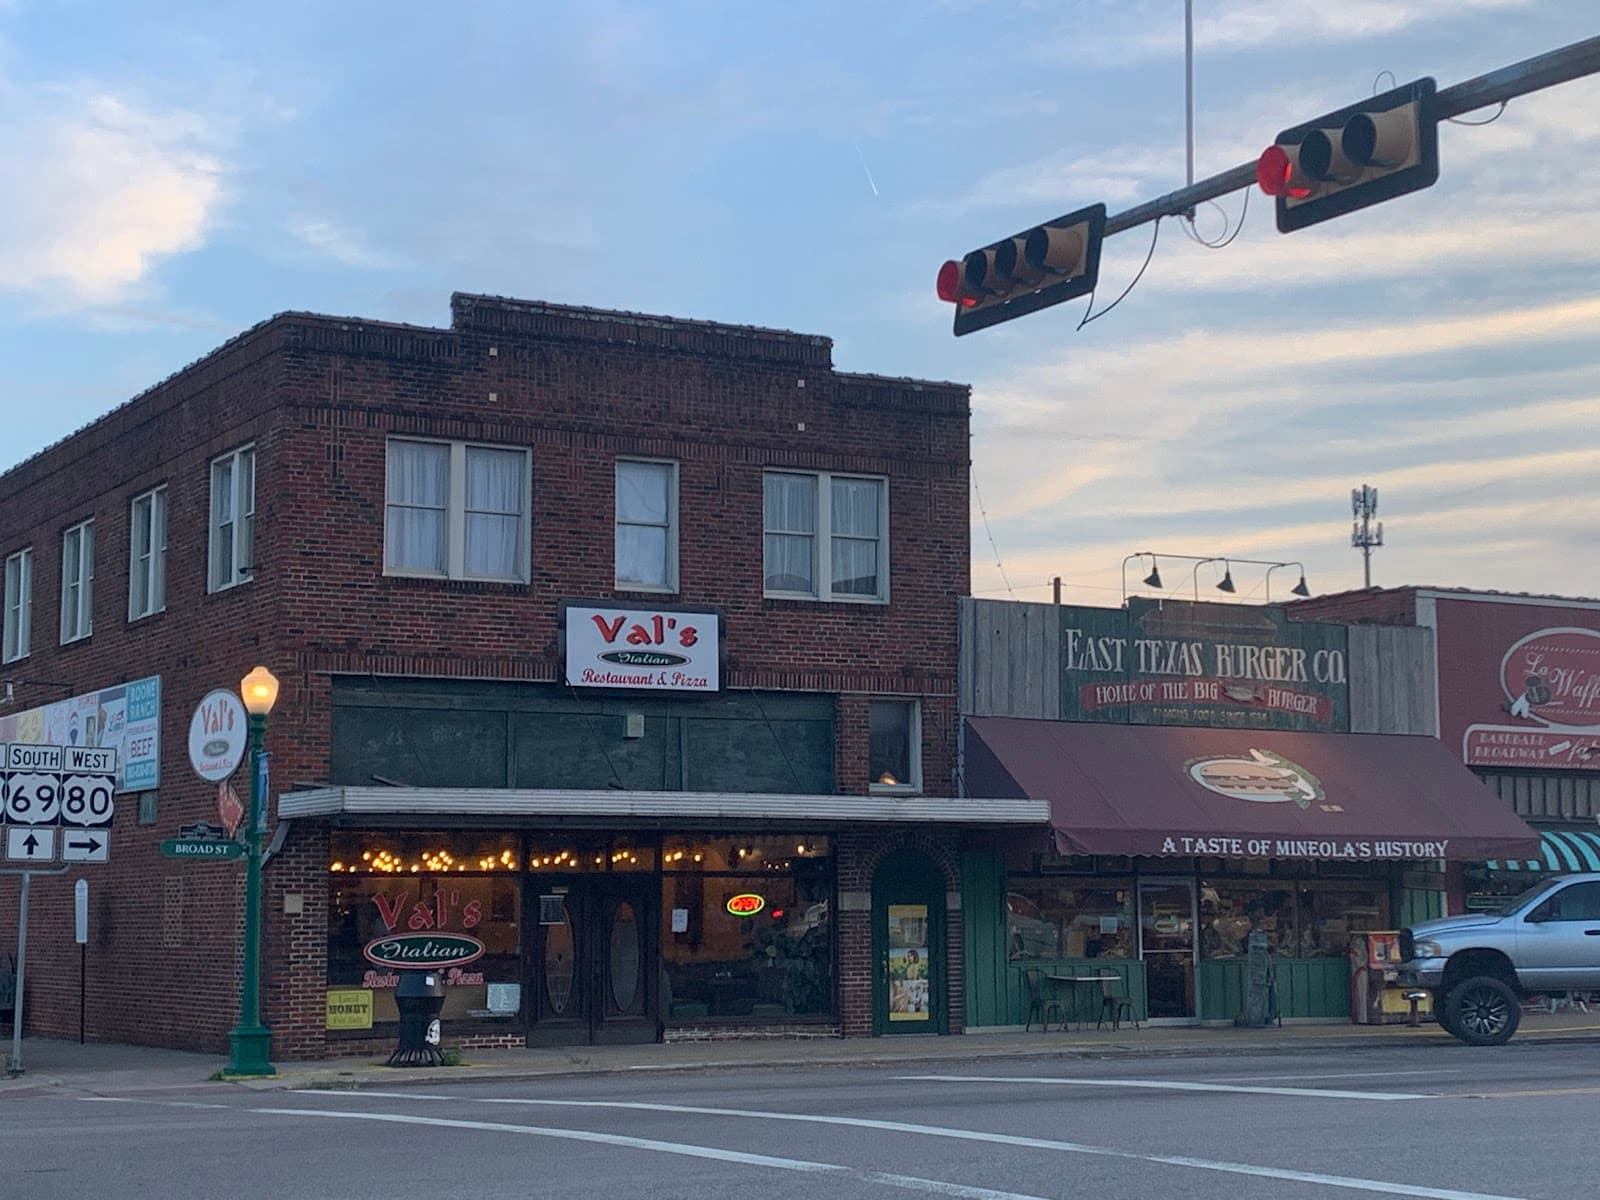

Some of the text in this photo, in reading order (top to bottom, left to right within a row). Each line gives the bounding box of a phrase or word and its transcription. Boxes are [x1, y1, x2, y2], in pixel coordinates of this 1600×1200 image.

[591, 613, 699, 648] Val's
[617, 652, 670, 666] Italian
[1064, 628, 1347, 684] EAST TEXAS BURGER CO.
[580, 667, 708, 688] Restaurant & Pizza
[1096, 684, 1137, 704] HOME
[1140, 683, 1156, 700] OF
[1161, 682, 1189, 699] THE
[1267, 689, 1318, 715] BURGER
[201, 698, 235, 736] Val's
[12, 748, 59, 767] SOUTH
[130, 737, 153, 758] BEEF
[72, 751, 109, 769] WEST
[11, 785, 56, 813] 69
[66, 785, 110, 815] 80
[175, 844, 229, 854] BROAD ST
[1162, 837, 1449, 858] A TASTE OF MINEOLA'S HISTORY
[372, 888, 482, 930] Val's
[731, 897, 760, 911] OPEN
[381, 941, 469, 959] Italian
